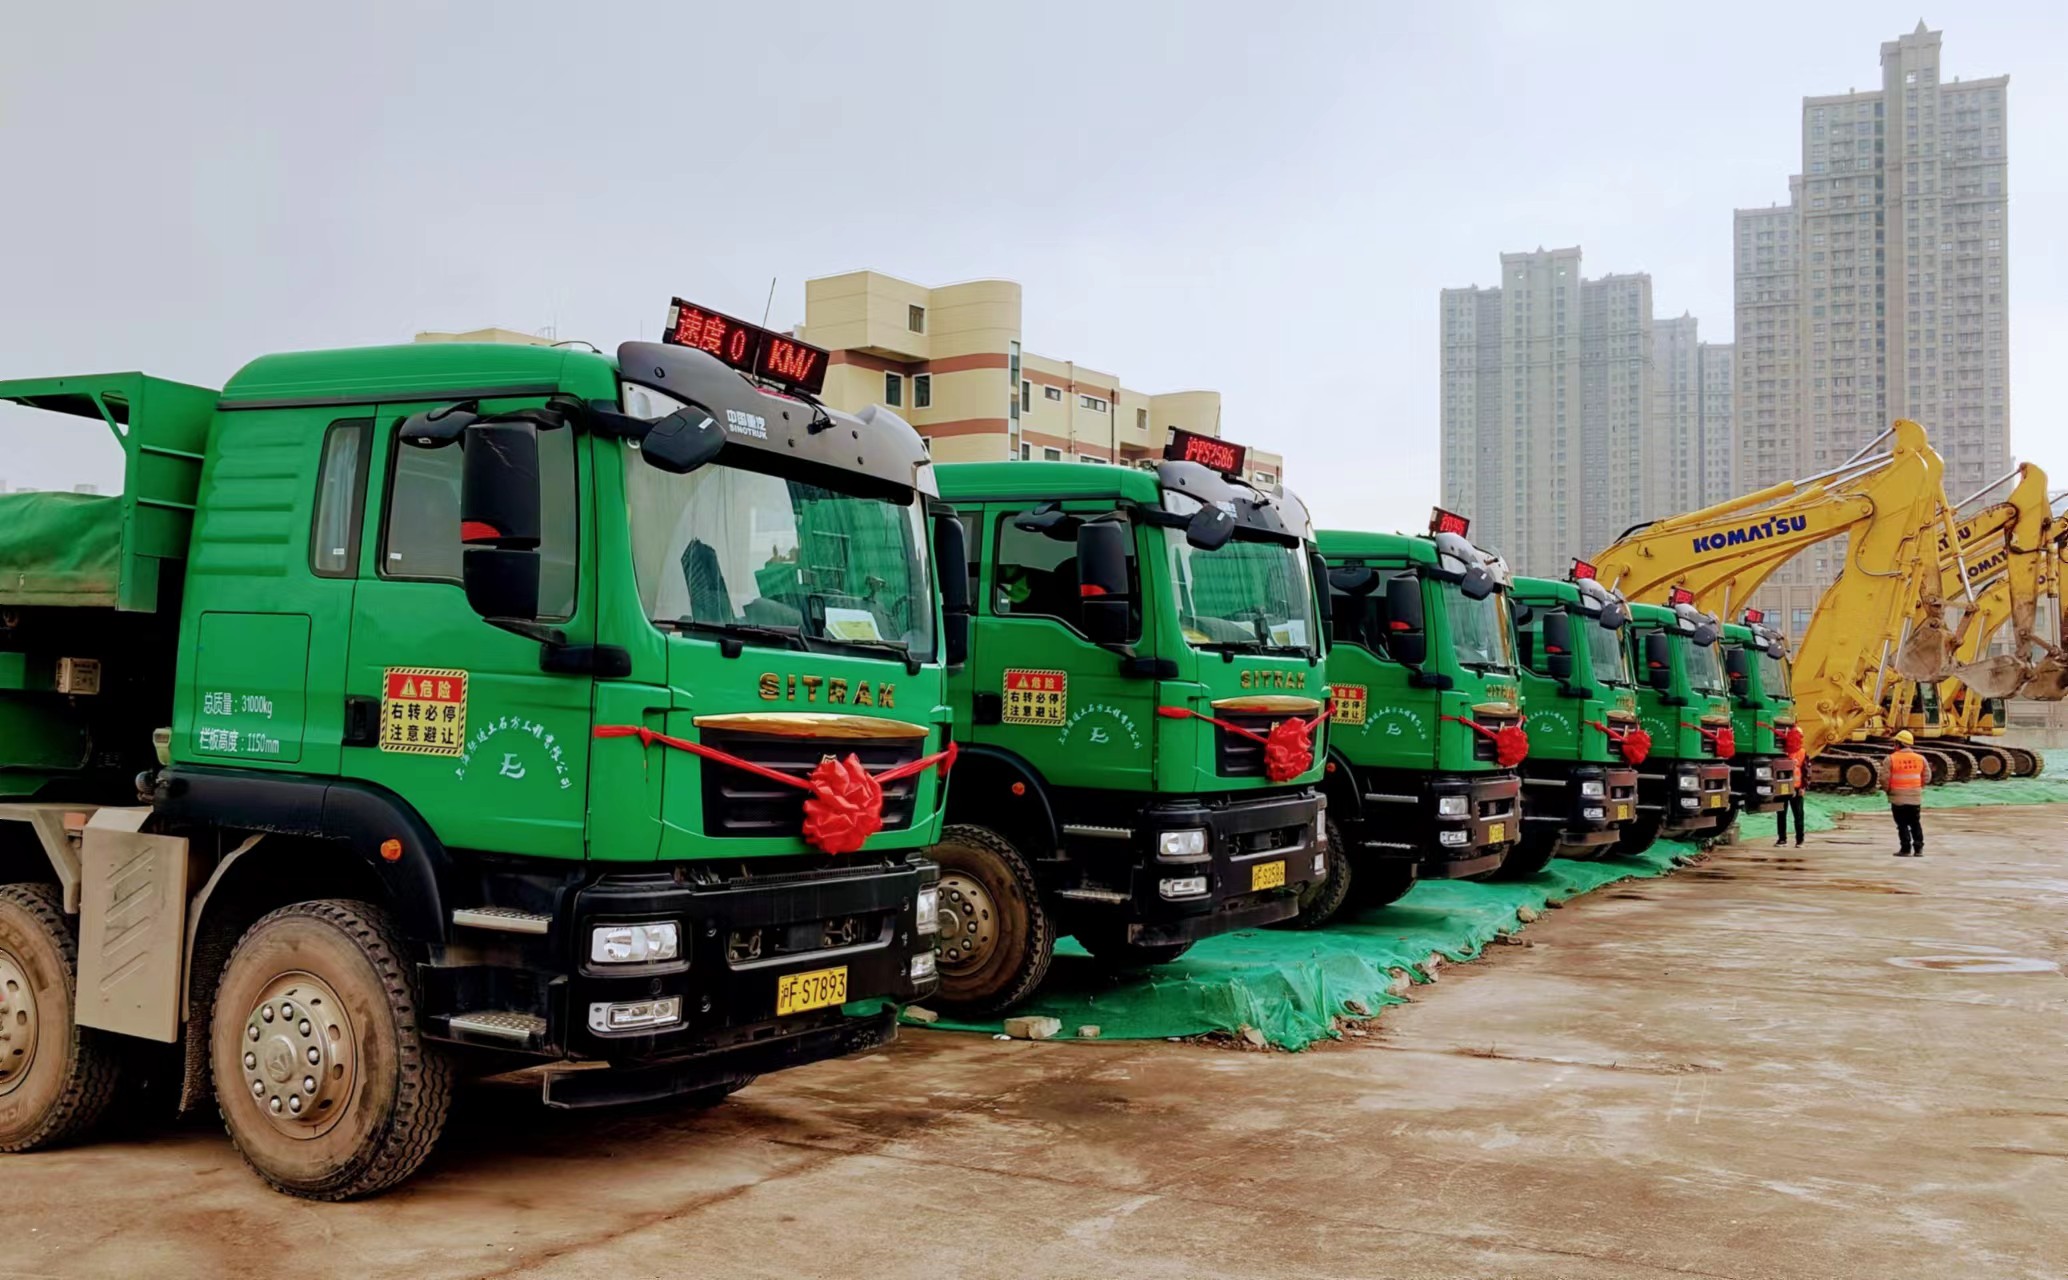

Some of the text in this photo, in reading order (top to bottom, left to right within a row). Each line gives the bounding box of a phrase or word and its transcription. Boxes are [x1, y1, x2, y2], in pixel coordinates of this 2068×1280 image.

[675, 308, 726, 355] 速度
[731, 329, 746, 360] 0
[1692, 515, 1807, 553] KOMATSU
[420, 680, 451, 699] 危险
[758, 672, 896, 708] SITRAK
[1241, 670, 1306, 689] SITRAK
[391, 702, 456, 722] 右转必停
[390, 724, 454, 745] 注意避让
